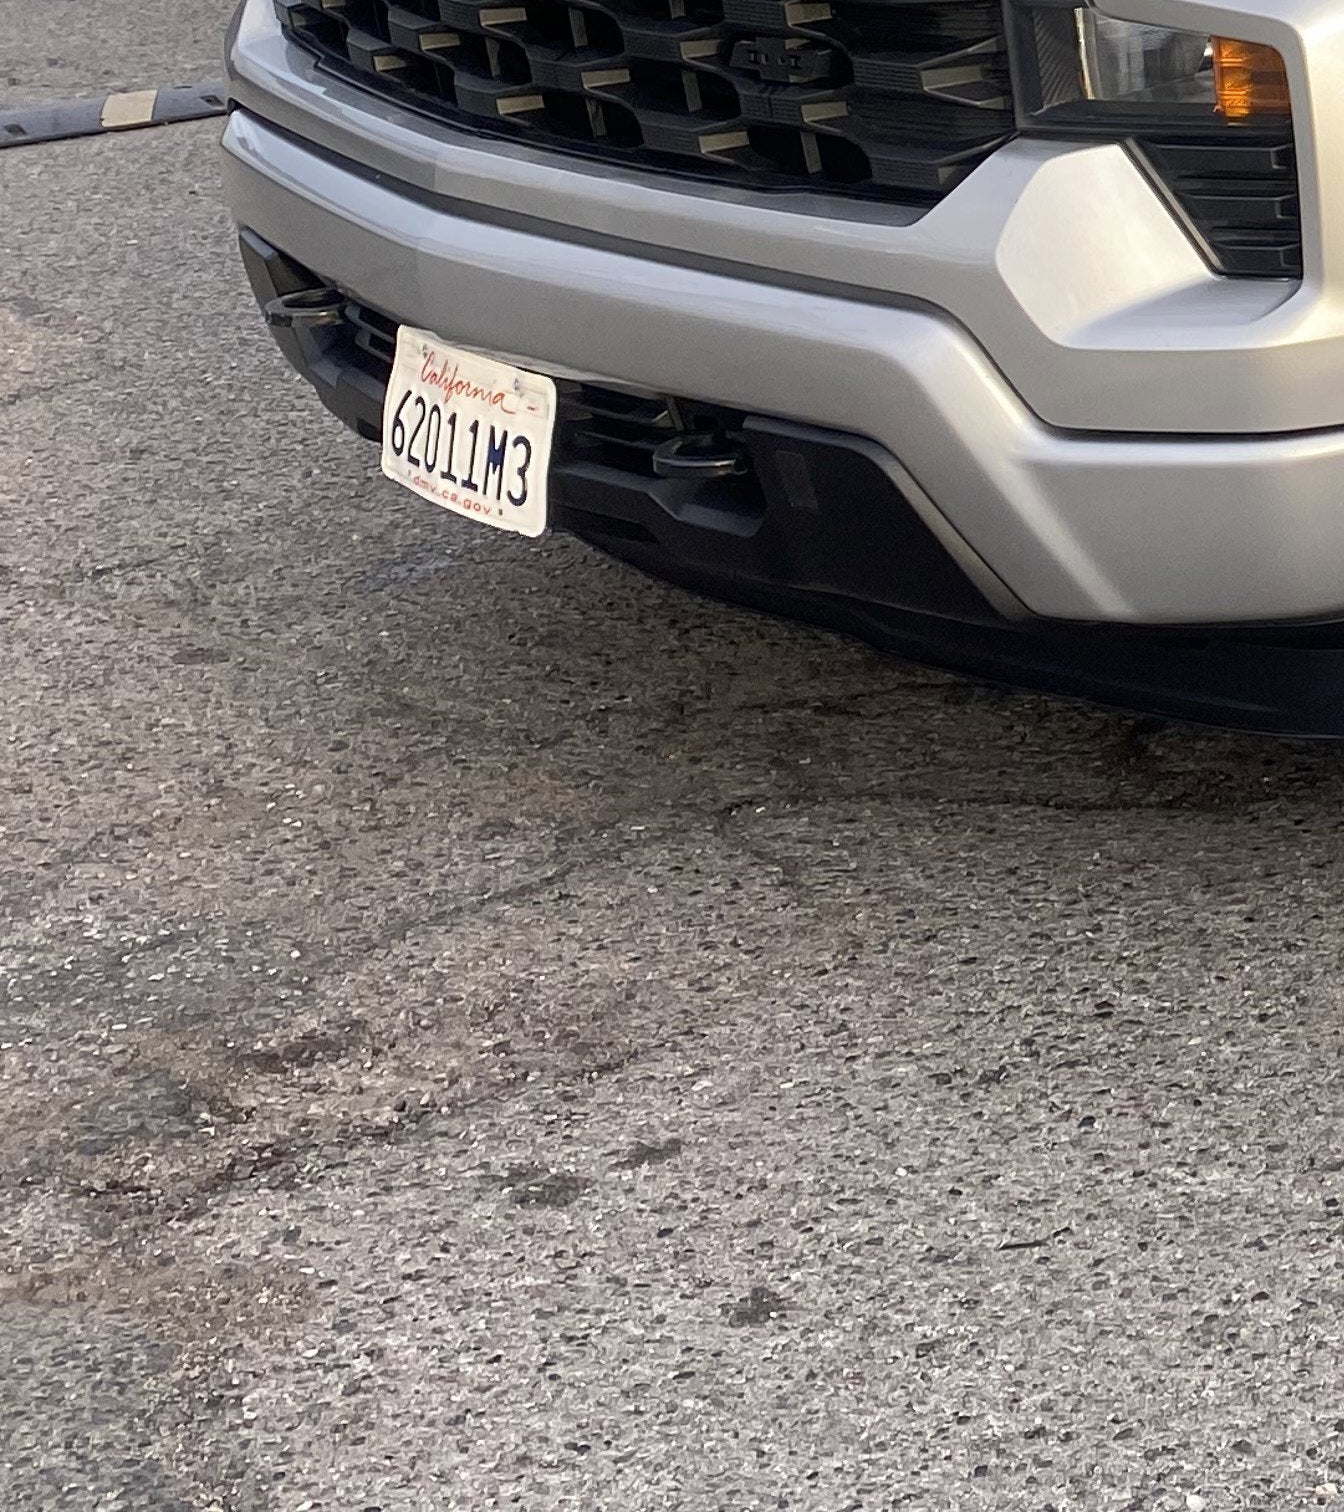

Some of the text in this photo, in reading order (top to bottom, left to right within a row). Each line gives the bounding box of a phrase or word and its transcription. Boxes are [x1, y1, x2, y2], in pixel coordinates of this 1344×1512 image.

[419, 351, 516, 415] California
[391, 390, 532, 507] 62011M3
[412, 476, 492, 516] dmv.ca.gov
